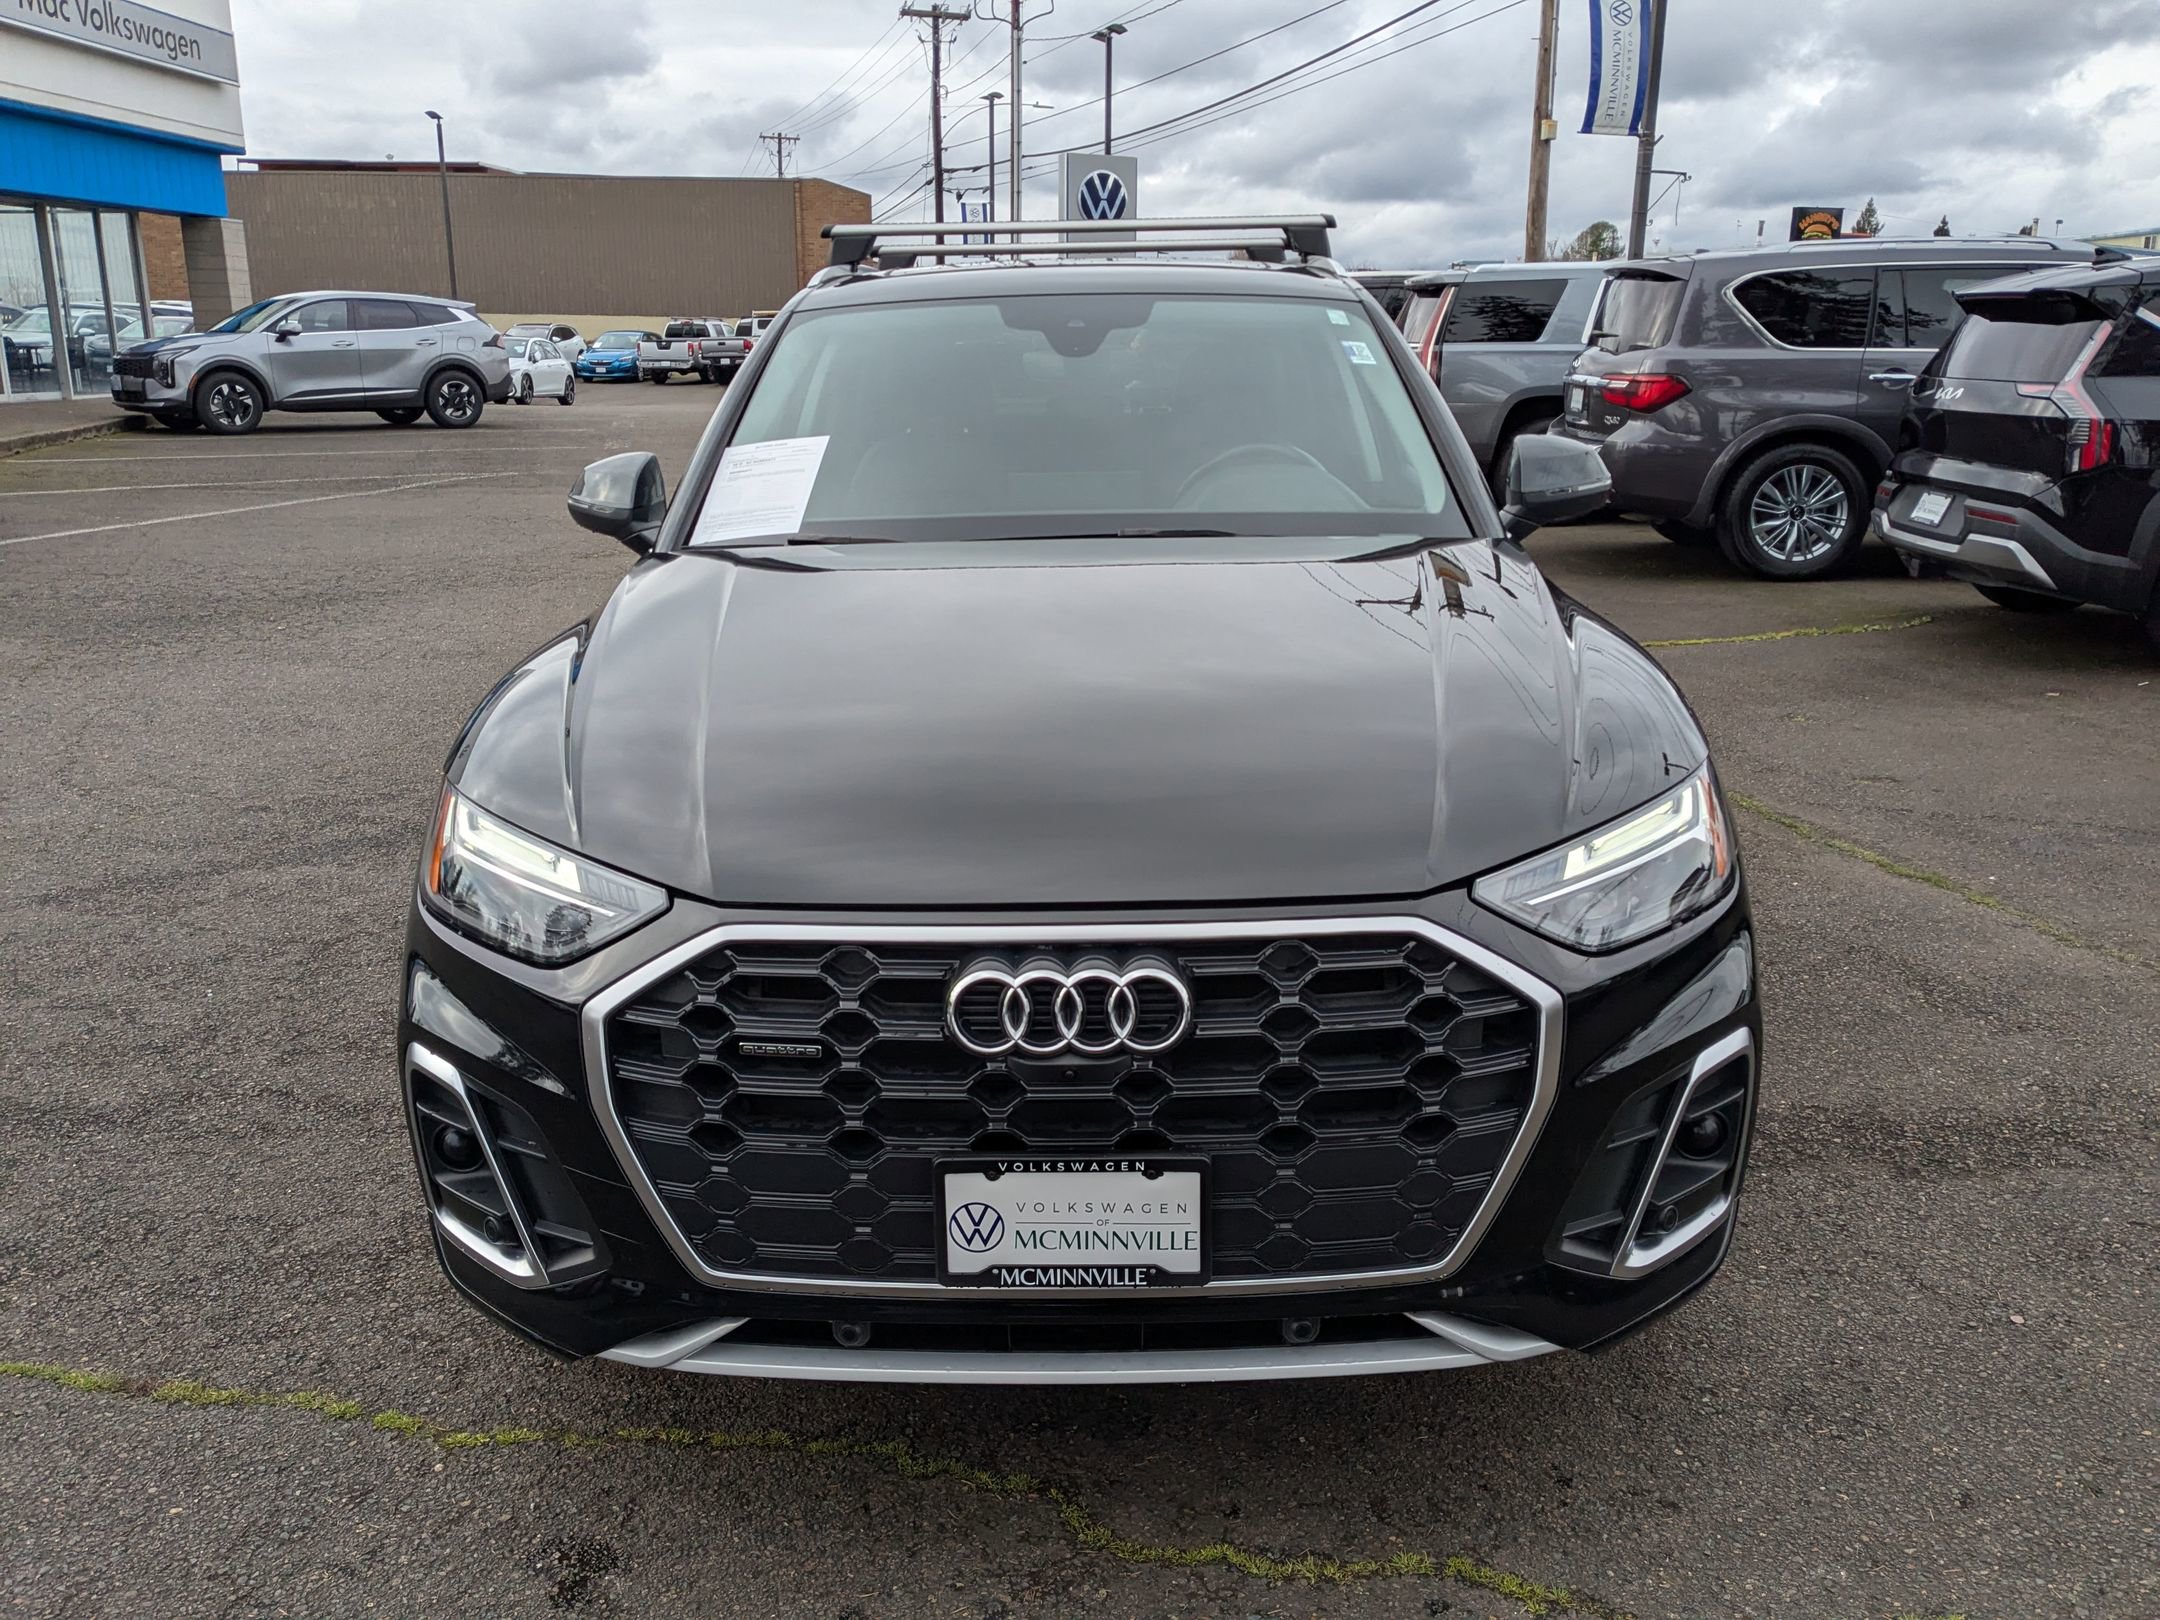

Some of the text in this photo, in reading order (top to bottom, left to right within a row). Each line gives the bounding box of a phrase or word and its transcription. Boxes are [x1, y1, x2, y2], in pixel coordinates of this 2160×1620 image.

[75, 0, 201, 60] Volkswagen
[1604, 29, 1622, 121] MCMINNVILLE
[1619, 32, 1633, 117] VOLKSWAGEN
[742, 1045, 818, 1056] quattro
[998, 1162, 1145, 1172] VOLKSWAGEN
[1016, 1202, 1188, 1214] VOLKSWAGEN
[1096, 1219, 1110, 1227] OF
[1014, 1229, 1198, 1251] MCMINNVILLE
[1000, 1268, 1148, 1286] MCMINNVILLE
